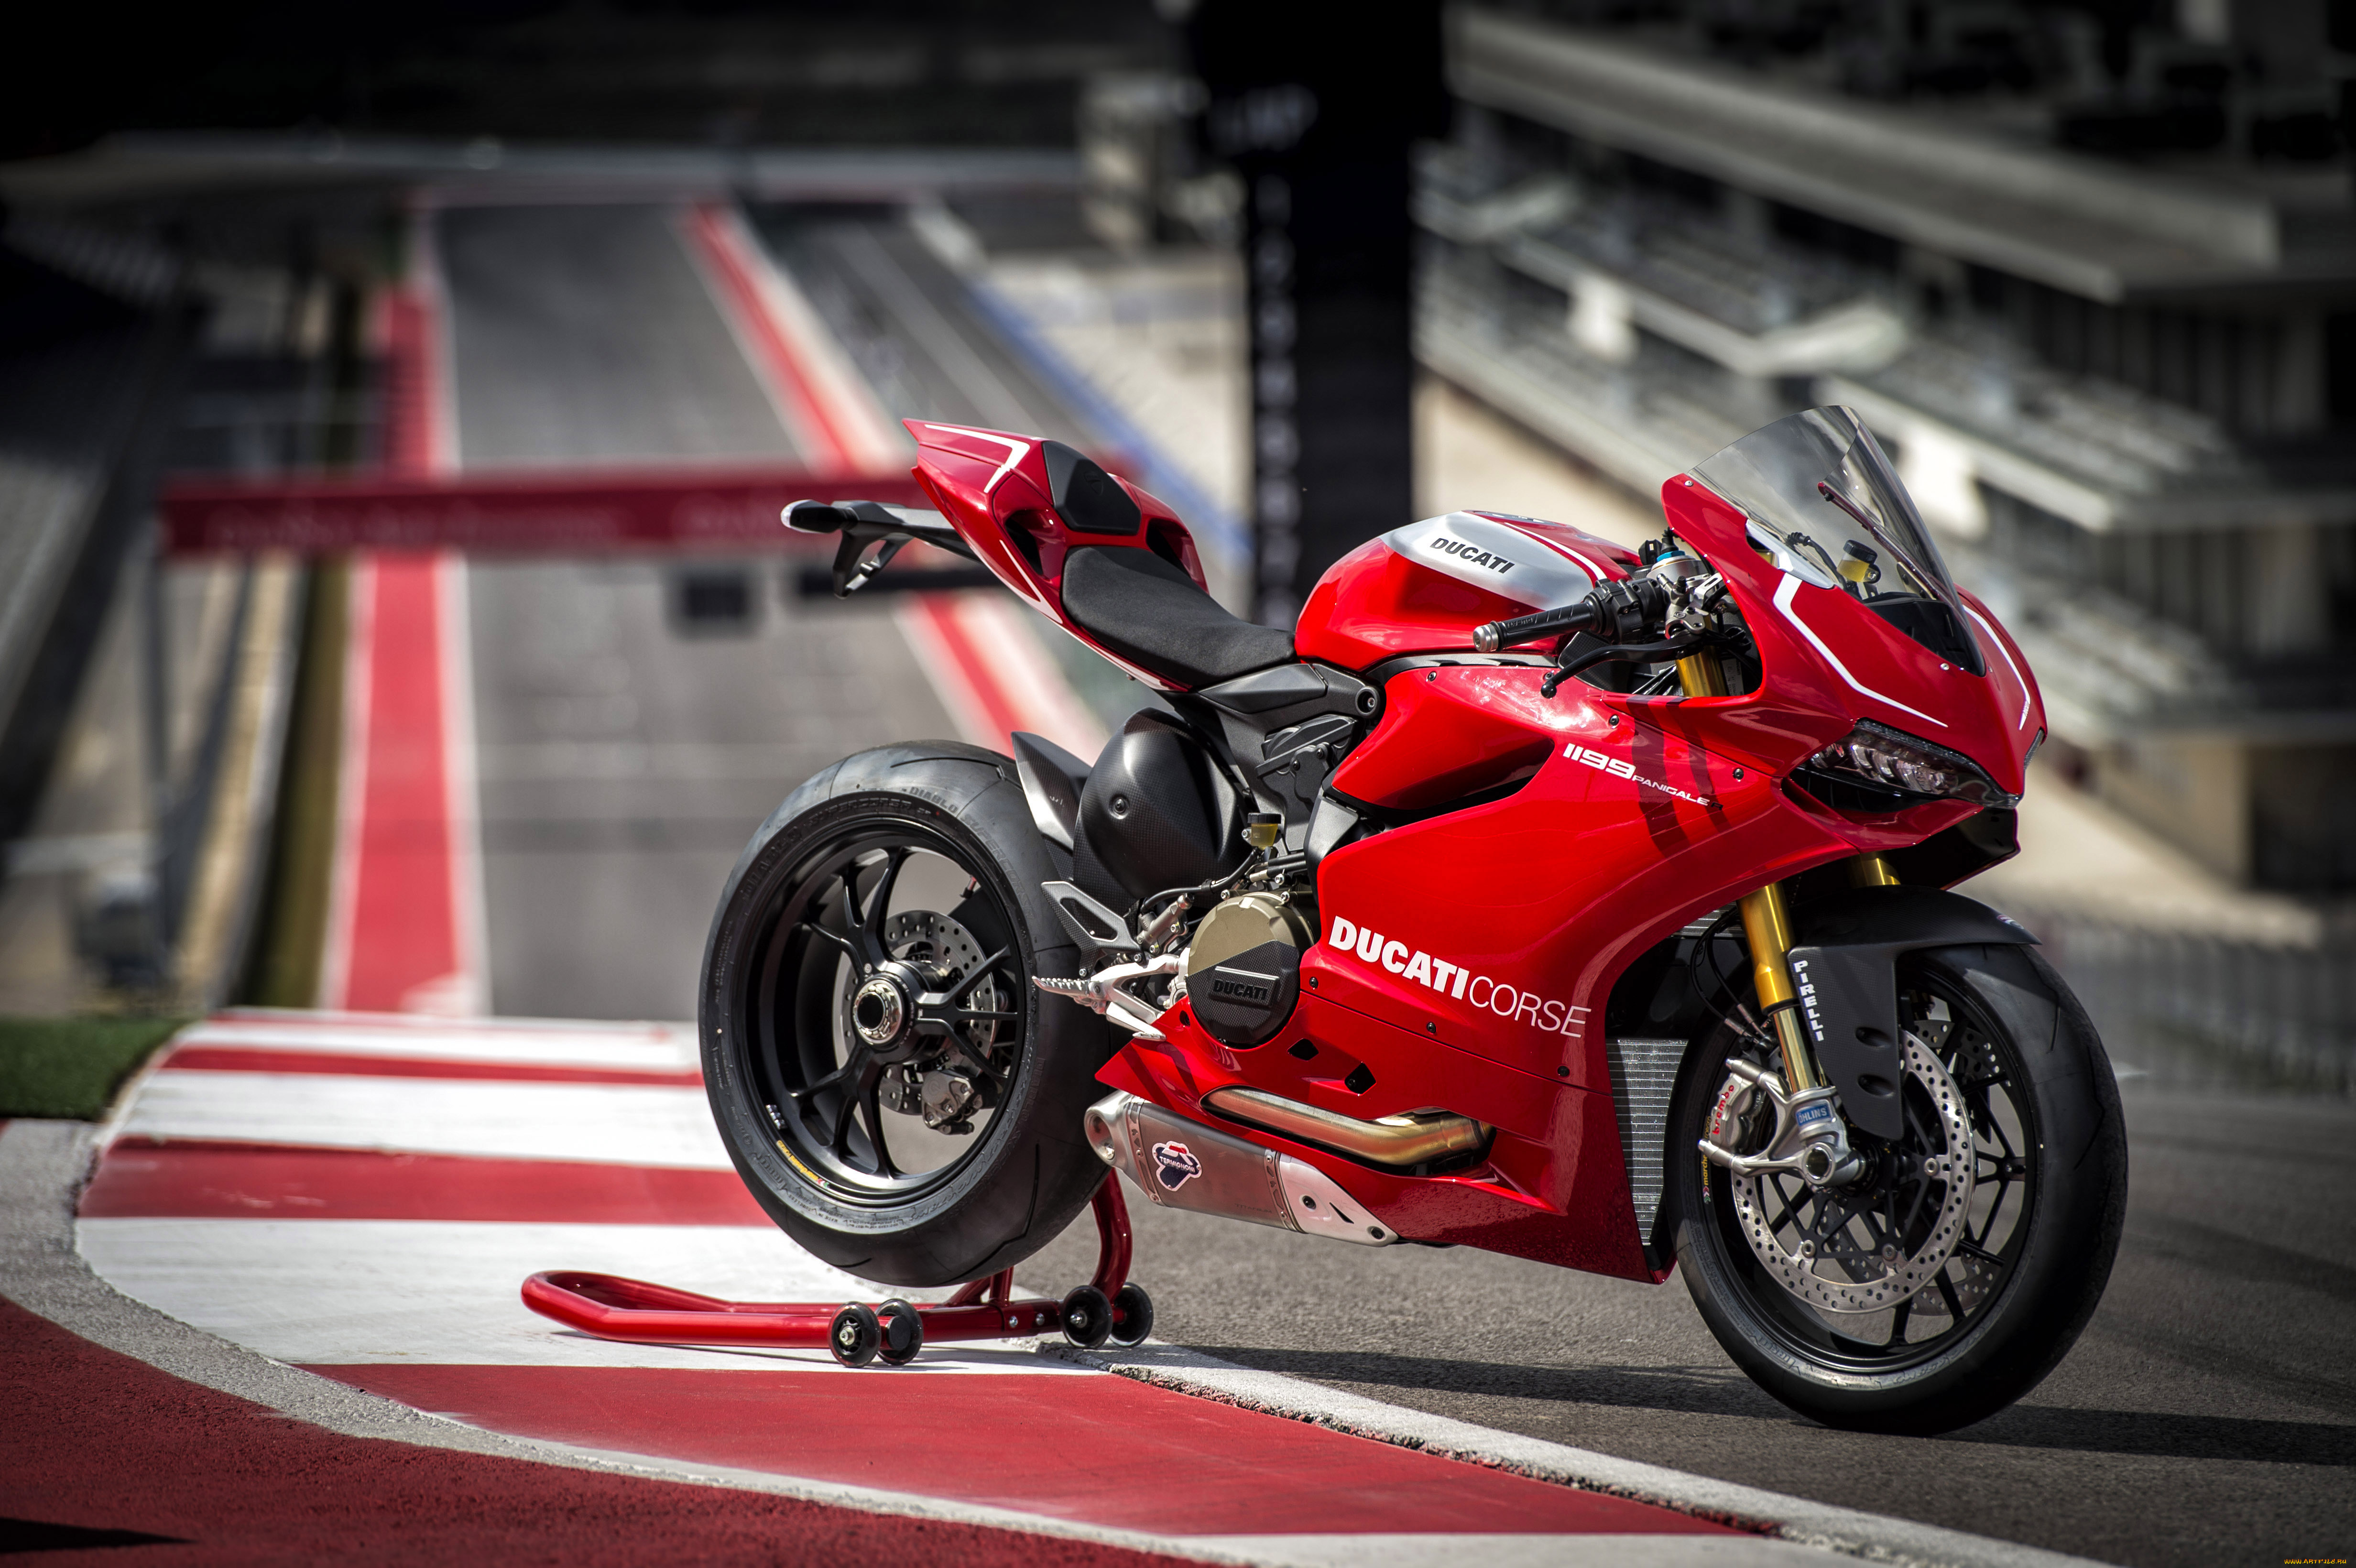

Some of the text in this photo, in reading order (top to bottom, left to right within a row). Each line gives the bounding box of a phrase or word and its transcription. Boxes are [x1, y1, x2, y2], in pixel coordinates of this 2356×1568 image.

[1429, 538, 1515, 574] DUCATI
[1562, 743, 1723, 810] 1199 PANIGALE R
[909, 785, 959, 815] DIABLO
[1213, 979, 1268, 1001] DUCATI
[1329, 915, 1592, 1037] DUCATI CORSE
[1793, 960, 1824, 1042] PIRELLI
[1712, 1085, 1734, 1134] brembo
[1798, 1107, 1827, 1124] ÖHLINS
[1159, 1156, 1195, 1173] TERMIGNONI
